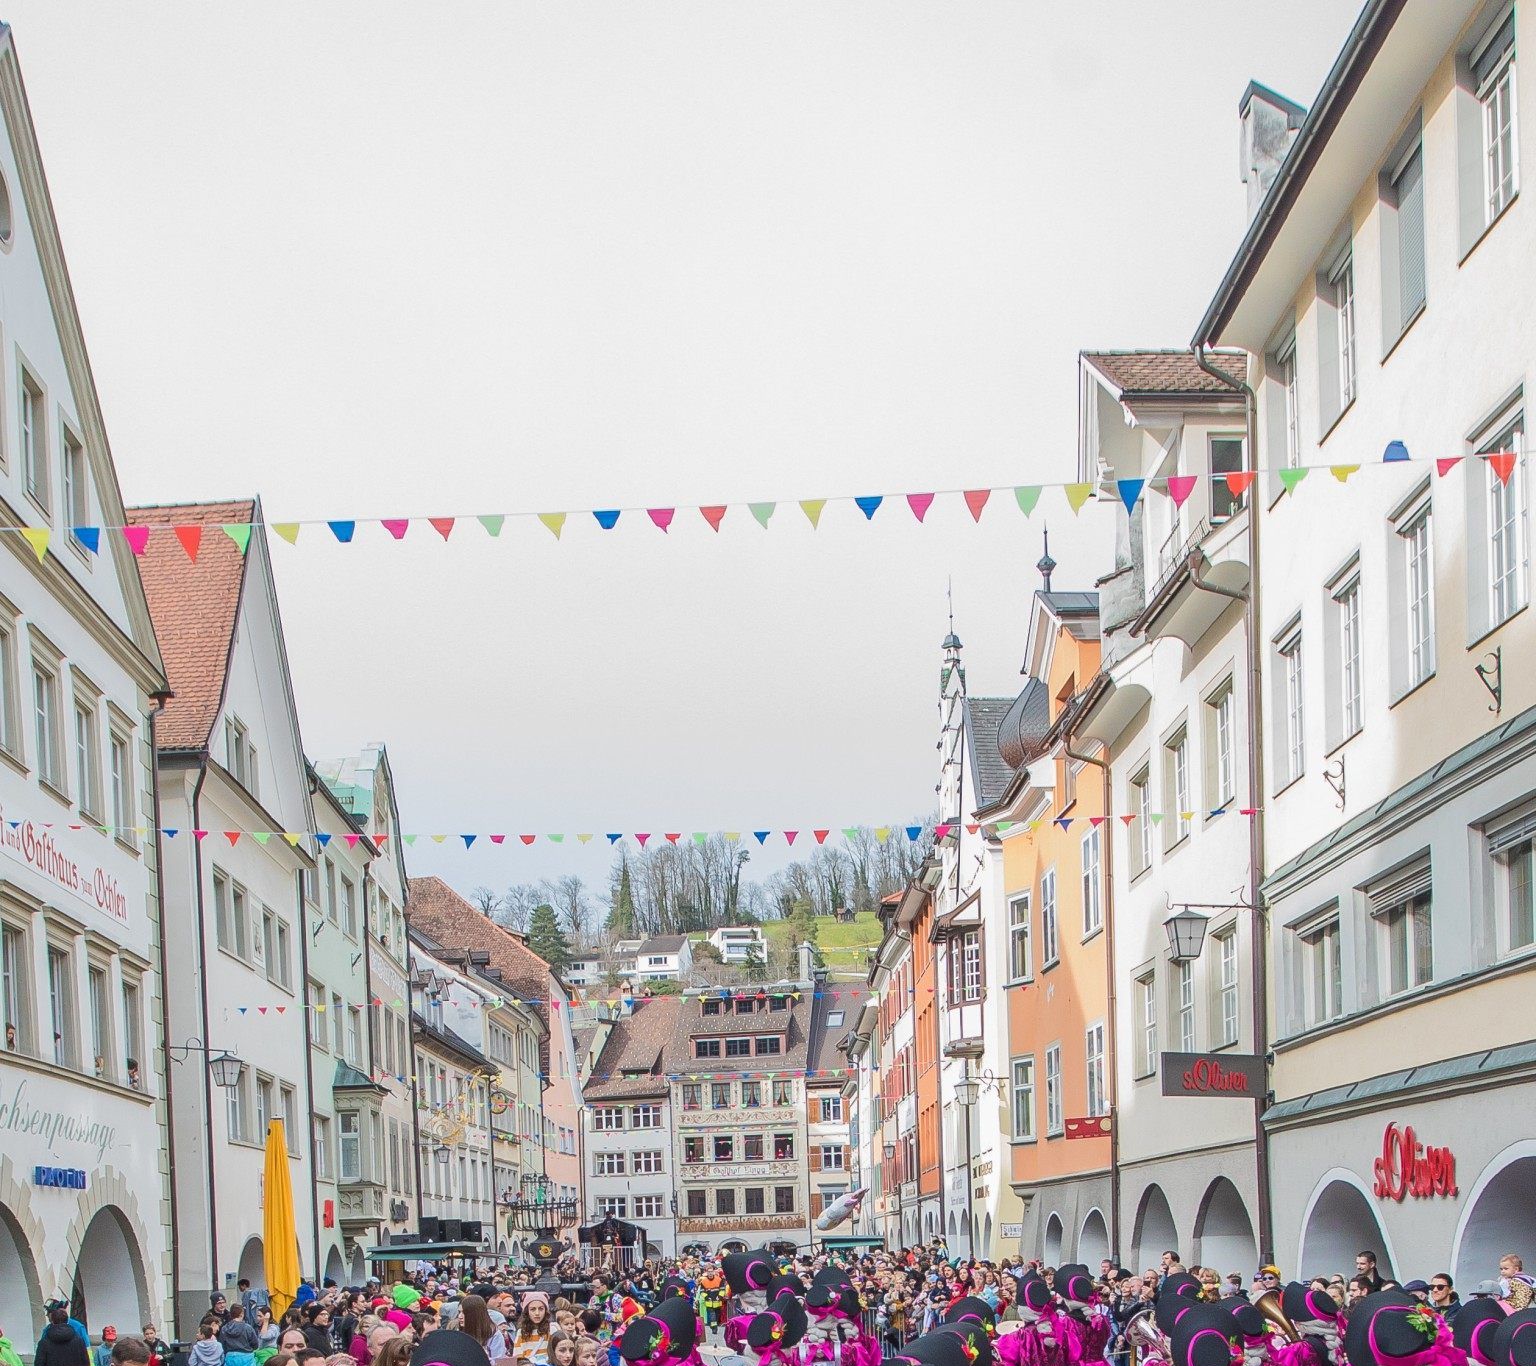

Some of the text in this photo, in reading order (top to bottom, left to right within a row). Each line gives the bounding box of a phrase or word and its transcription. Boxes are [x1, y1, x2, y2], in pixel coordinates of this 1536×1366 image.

[22, 819, 79, 890] Gasthaus
[93, 867, 127, 921] Ochsen
[0, 1080, 115, 1163] chsenpassage
